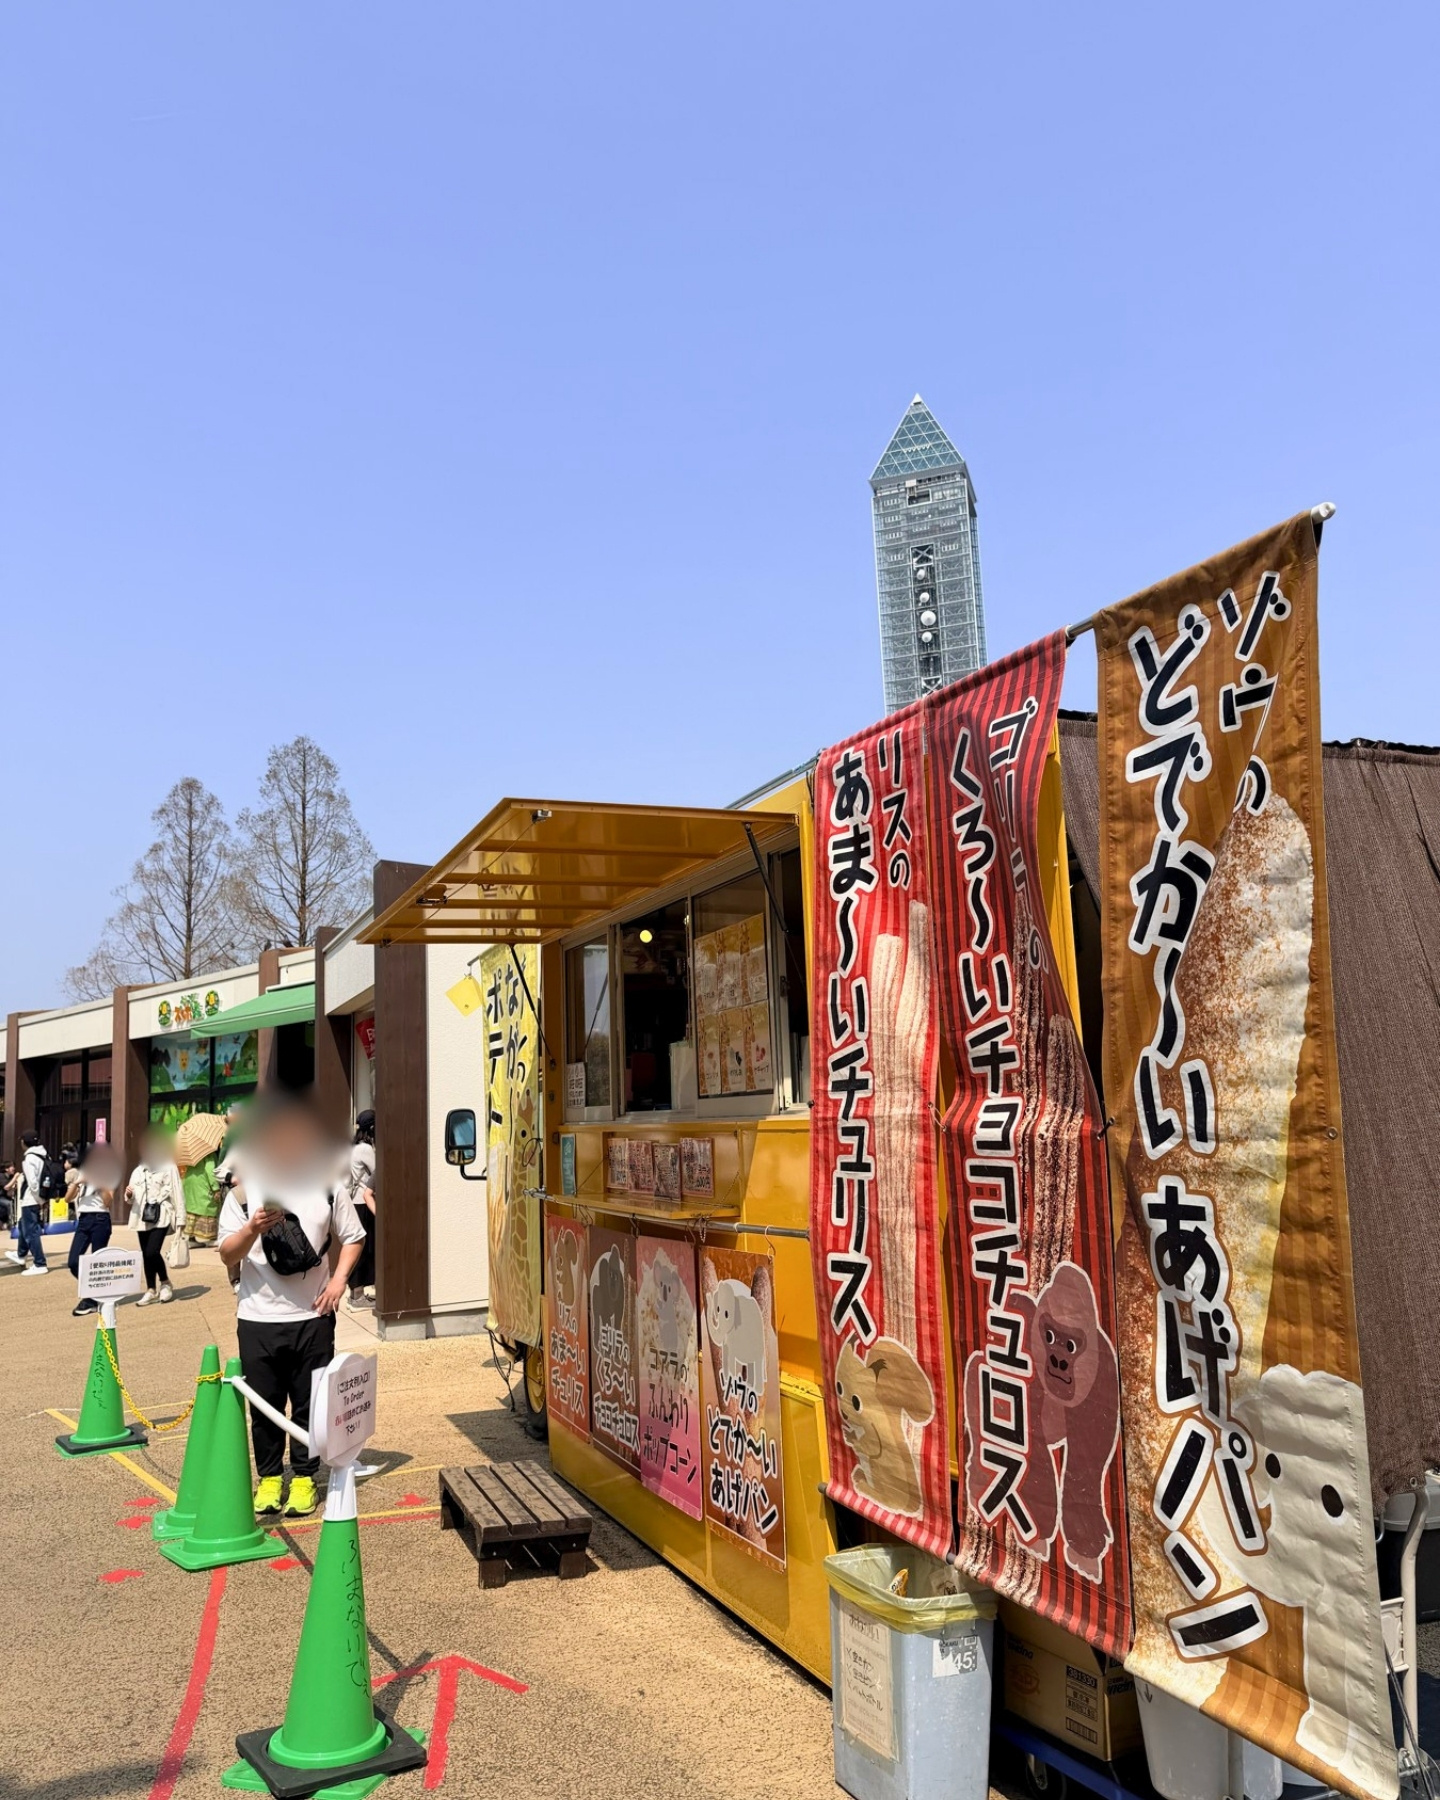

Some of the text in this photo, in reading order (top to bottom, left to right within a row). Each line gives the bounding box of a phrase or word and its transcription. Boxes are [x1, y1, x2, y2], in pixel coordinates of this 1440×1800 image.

[879, 728, 912, 891] リスの
[486, 970, 504, 1132] ポテト
[559, 1303, 578, 1336] リスの
[649, 1347, 688, 1382] コアラの
[719, 1369, 758, 1415] ゾウの
[551, 1366, 586, 1419] チュリス
[648, 1383, 689, 1435] ふんわり
[593, 1392, 640, 1456] チョコチュロス
[644, 1426, 696, 1484] ポップコーン
[709, 1457, 779, 1534] あげパン
